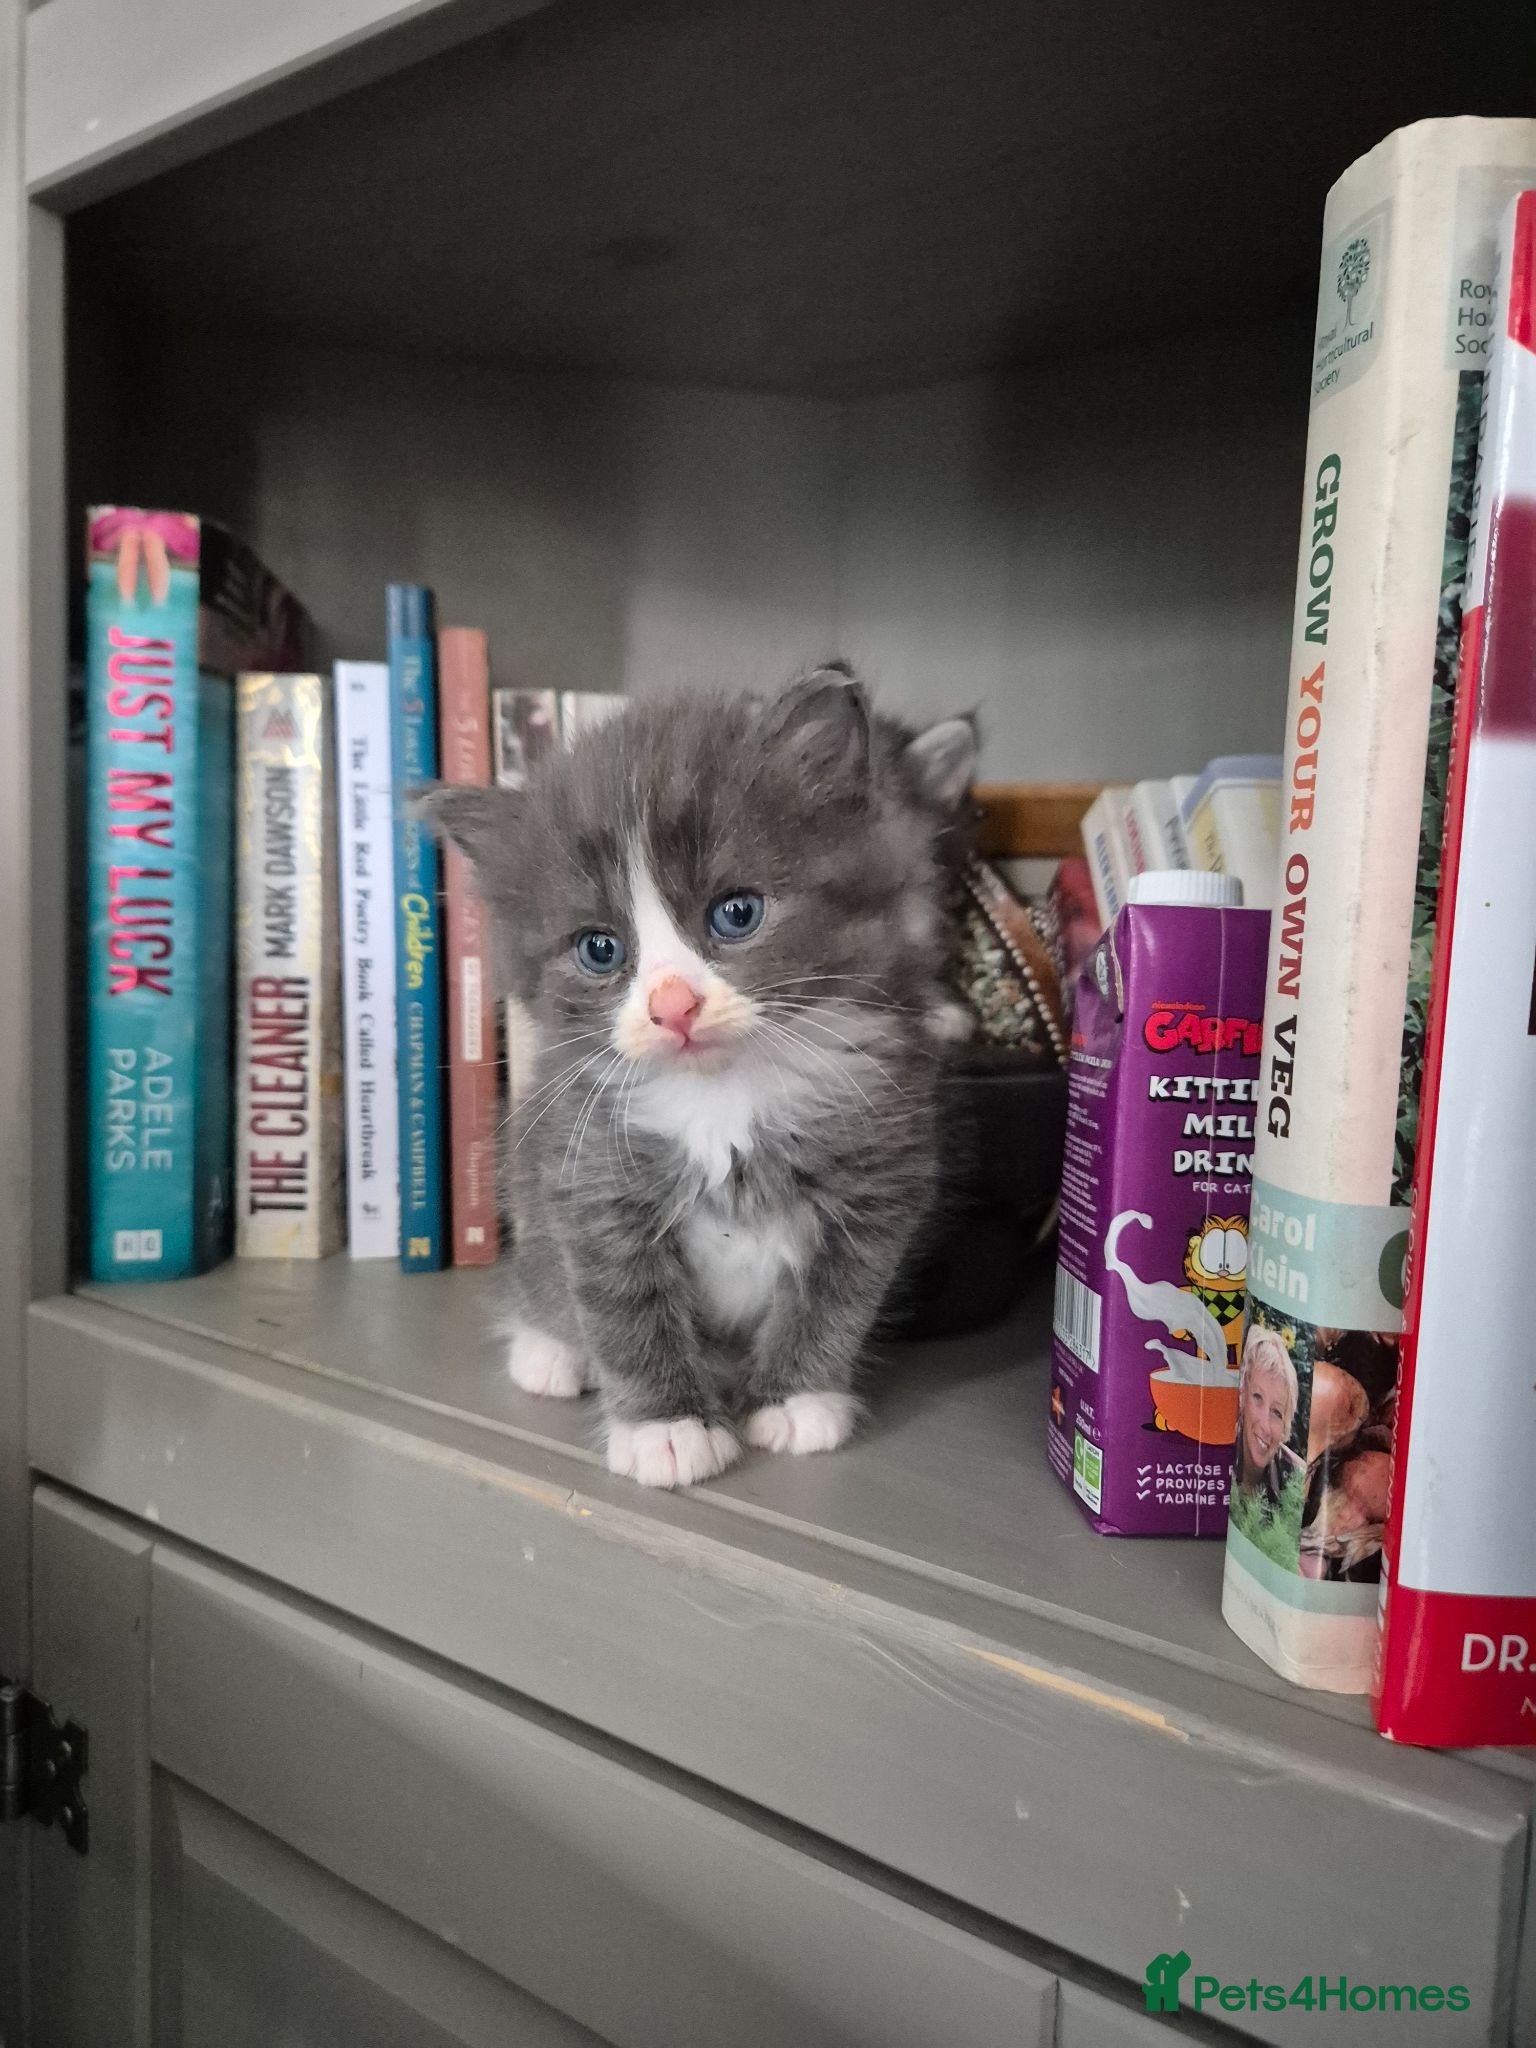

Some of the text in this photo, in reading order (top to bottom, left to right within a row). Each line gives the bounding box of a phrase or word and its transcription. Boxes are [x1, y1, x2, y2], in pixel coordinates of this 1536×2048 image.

[107, 626, 176, 997] JUST MY LUCK
[1267, 453, 1342, 1139] GROW YOUR OWN VEG
[264, 766, 297, 958] MARK DAWSON
[353, 840, 369, 878] Red
[353, 888, 371, 944] Poetry
[401, 893, 433, 990] Children
[356, 957, 373, 1003] Book
[357, 1012, 375, 1070] Called
[404, 1001, 425, 1094] CHAPMAN
[1144, 1010, 1263, 1056] GARFI
[105, 1047, 137, 1172] PARKS
[140, 1046, 174, 1170] ADELE
[249, 974, 310, 1216] THE CLEANER
[360, 1080, 377, 1181] Heartbreak
[1183, 1113, 1255, 1139] MIL
[1174, 1149, 1254, 1174] DRIN
[1192, 1181, 1252, 1195] FOR CAT
[1155, 1478, 1226, 1492] PROVIDES
[1156, 1463, 1222, 1476] LACTOSE
[1155, 1493, 1217, 1506] TAURINE
[1460, 1632, 1536, 1673] DR.
